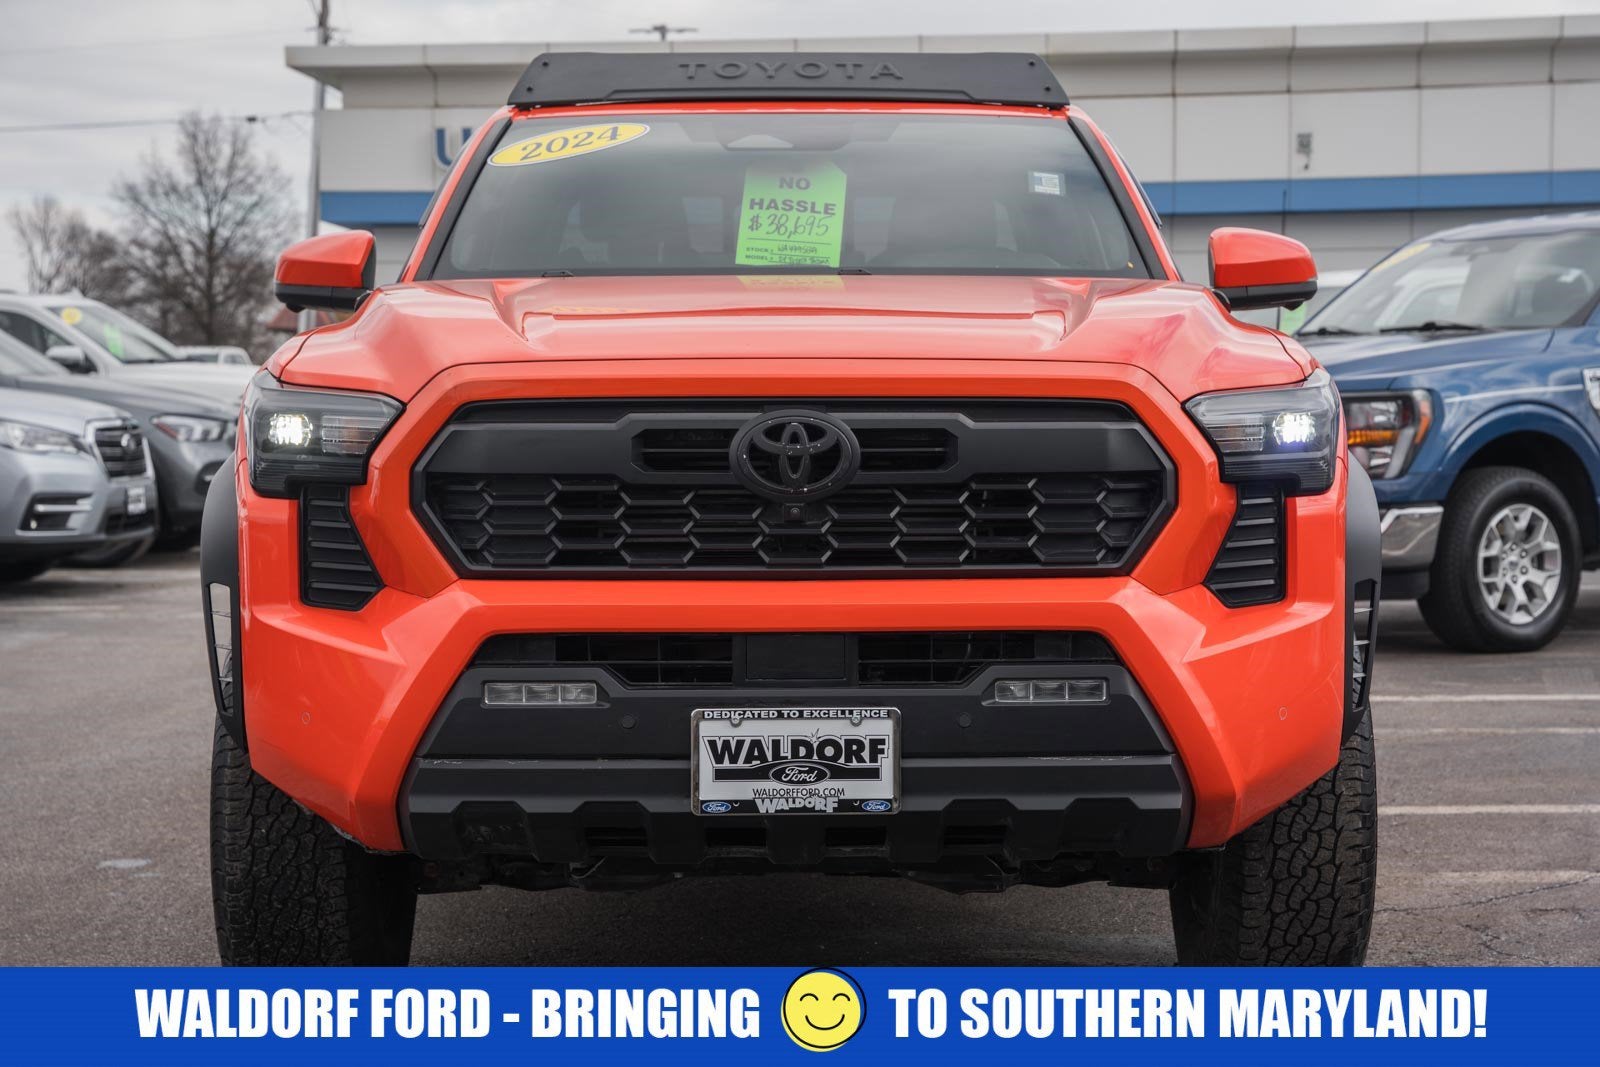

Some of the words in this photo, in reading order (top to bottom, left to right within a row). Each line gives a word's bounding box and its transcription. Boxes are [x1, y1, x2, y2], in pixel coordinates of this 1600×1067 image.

[678, 61, 904, 81] TOYOTA
[519, 125, 622, 162] 2024
[778, 176, 811, 191] NO
[749, 198, 837, 216] HASSLE
[704, 710, 779, 719] DEDICATED
[782, 710, 799, 718] TO
[803, 709, 889, 718] EXCELLENCE
[705, 737, 887, 765] WALDORF
[781, 766, 818, 783] Ford
[752, 787, 845, 797] WALDORFFORD.COM
[706, 803, 728, 812] Ford
[753, 796, 839, 814] WALDORF
[865, 802, 887, 811] Ford
